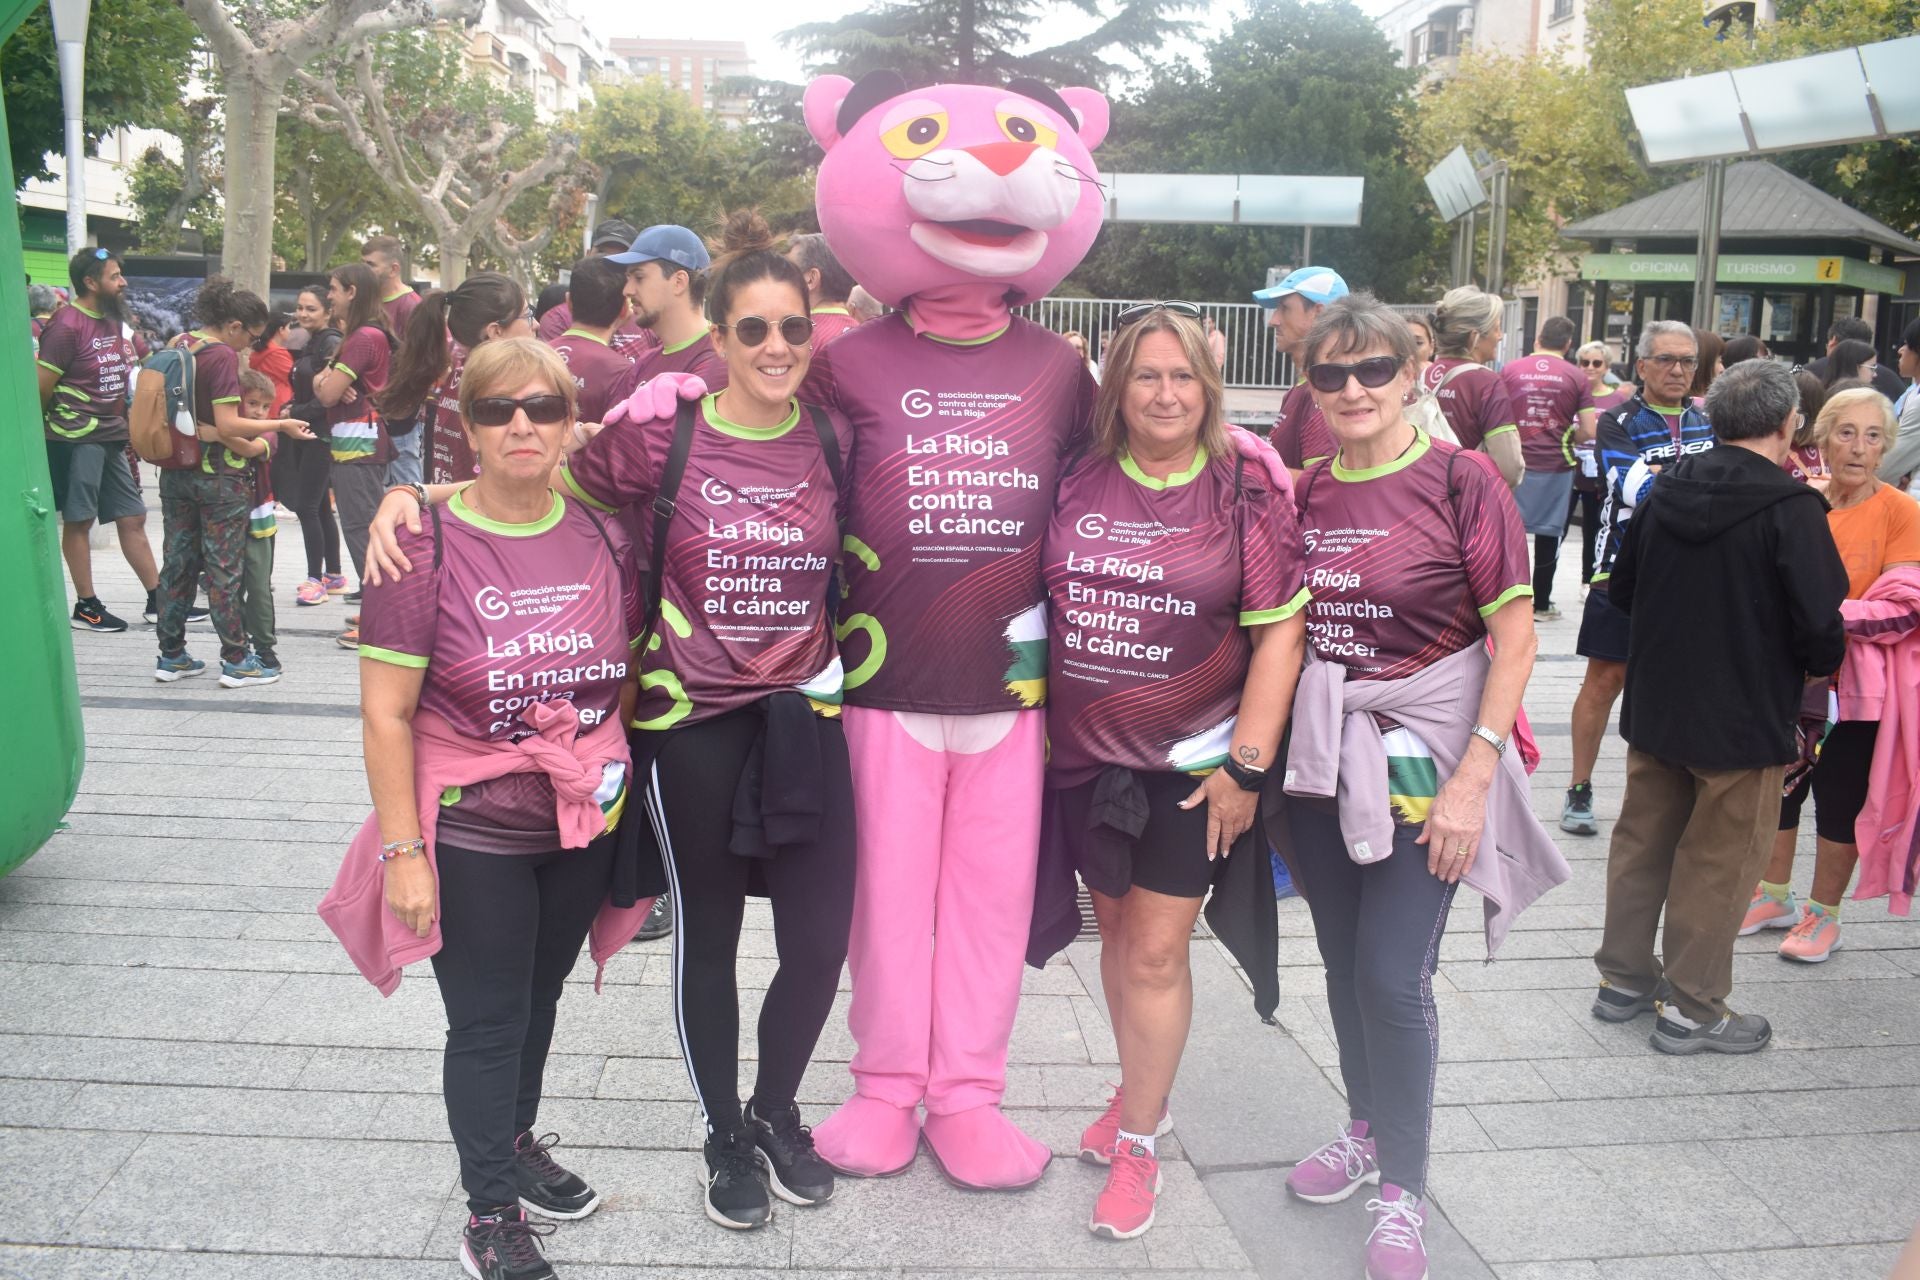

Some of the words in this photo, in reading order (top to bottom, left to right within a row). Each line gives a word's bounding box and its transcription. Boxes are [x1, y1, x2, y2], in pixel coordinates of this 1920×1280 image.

[1630, 262, 1688, 273] OFICINA
[1724, 263, 1797, 274] TURISMO
[1520, 374, 1563, 383] CALAHORRA
[938, 392, 982, 400] asociación
[985, 393, 1022, 402] española
[938, 400, 966, 408] contra
[968, 400, 976, 408] el
[978, 400, 1006, 408] cáncer
[964, 410, 986, 418] Rioja
[906, 434, 938, 454] La
[946, 434, 1009, 460] Rioja
[908, 466, 940, 486] En
[948, 467, 1039, 490] marcha
[908, 490, 993, 510] contra
[708, 518, 738, 540] La
[745, 520, 804, 546] Rioja
[908, 513, 934, 534] el
[940, 512, 1024, 536] cáncer
[1110, 528, 1137, 536] contra
[1113, 520, 1154, 529] asociación
[1324, 528, 1356, 536] asociación
[1356, 528, 1390, 536] española
[1120, 536, 1130, 544] La
[1131, 538, 1152, 546] Rioja
[1341, 536, 1348, 544] el
[1348, 536, 1372, 544] cáncer
[1336, 545, 1352, 554] Rioja
[707, 548, 738, 570] En
[744, 552, 828, 570] marcha
[1066, 551, 1096, 574] La
[1101, 556, 1164, 584] Rioja
[705, 574, 782, 592] contra
[1312, 568, 1360, 592] Rioja
[510, 586, 556, 598] asociación
[557, 583, 592, 593] española
[1068, 582, 1097, 604] En
[1102, 590, 1197, 616] marcha
[512, 596, 542, 606] contra
[542, 594, 550, 604] el
[551, 593, 580, 602] cáncer
[704, 595, 727, 614] el
[732, 596, 810, 616] cáncer
[515, 608, 526, 616] en
[528, 606, 539, 614] La
[540, 604, 563, 616] Rioja
[1316, 599, 1394, 618] marcha
[736, 624, 764, 632] ESPAÑOLA
[1066, 610, 1140, 634] contra
[486, 636, 522, 658] La
[528, 628, 594, 656] Rioja
[1065, 630, 1082, 650] el
[1087, 634, 1174, 662] cáncer
[488, 670, 524, 692] En
[532, 659, 626, 686] marcha
[1088, 664, 1116, 674] ESPAÑOLA
[1116, 668, 1138, 676] CONTRA
[1146, 672, 1170, 680] CÁNCER
